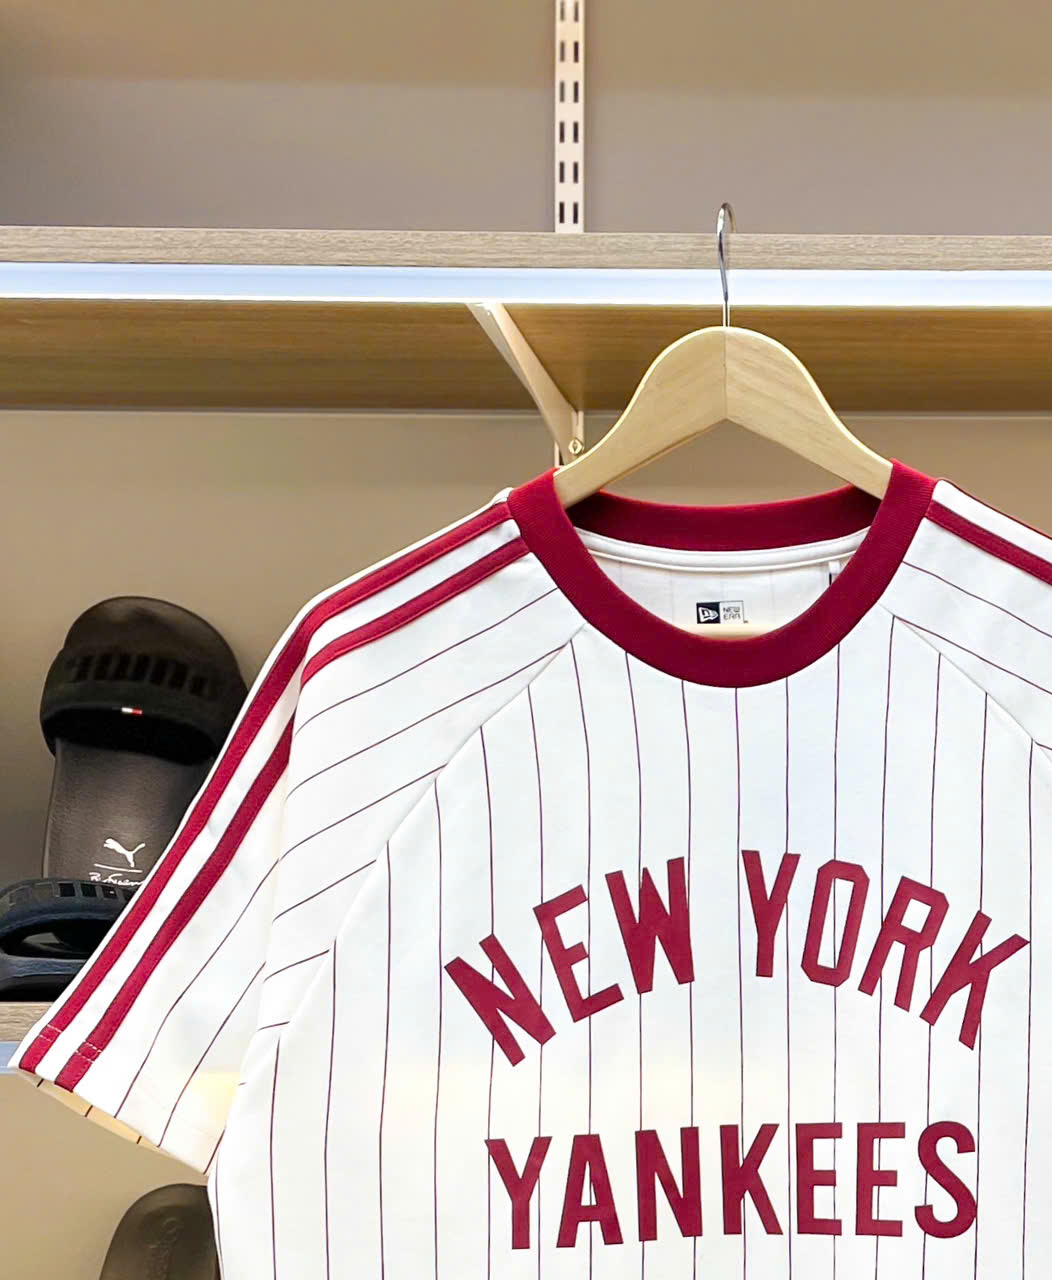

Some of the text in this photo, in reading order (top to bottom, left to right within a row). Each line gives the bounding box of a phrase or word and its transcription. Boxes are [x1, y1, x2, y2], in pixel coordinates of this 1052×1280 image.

[444, 850, 1030, 1067] NEW YORK
[485, 1121, 977, 1249] YANKEES
